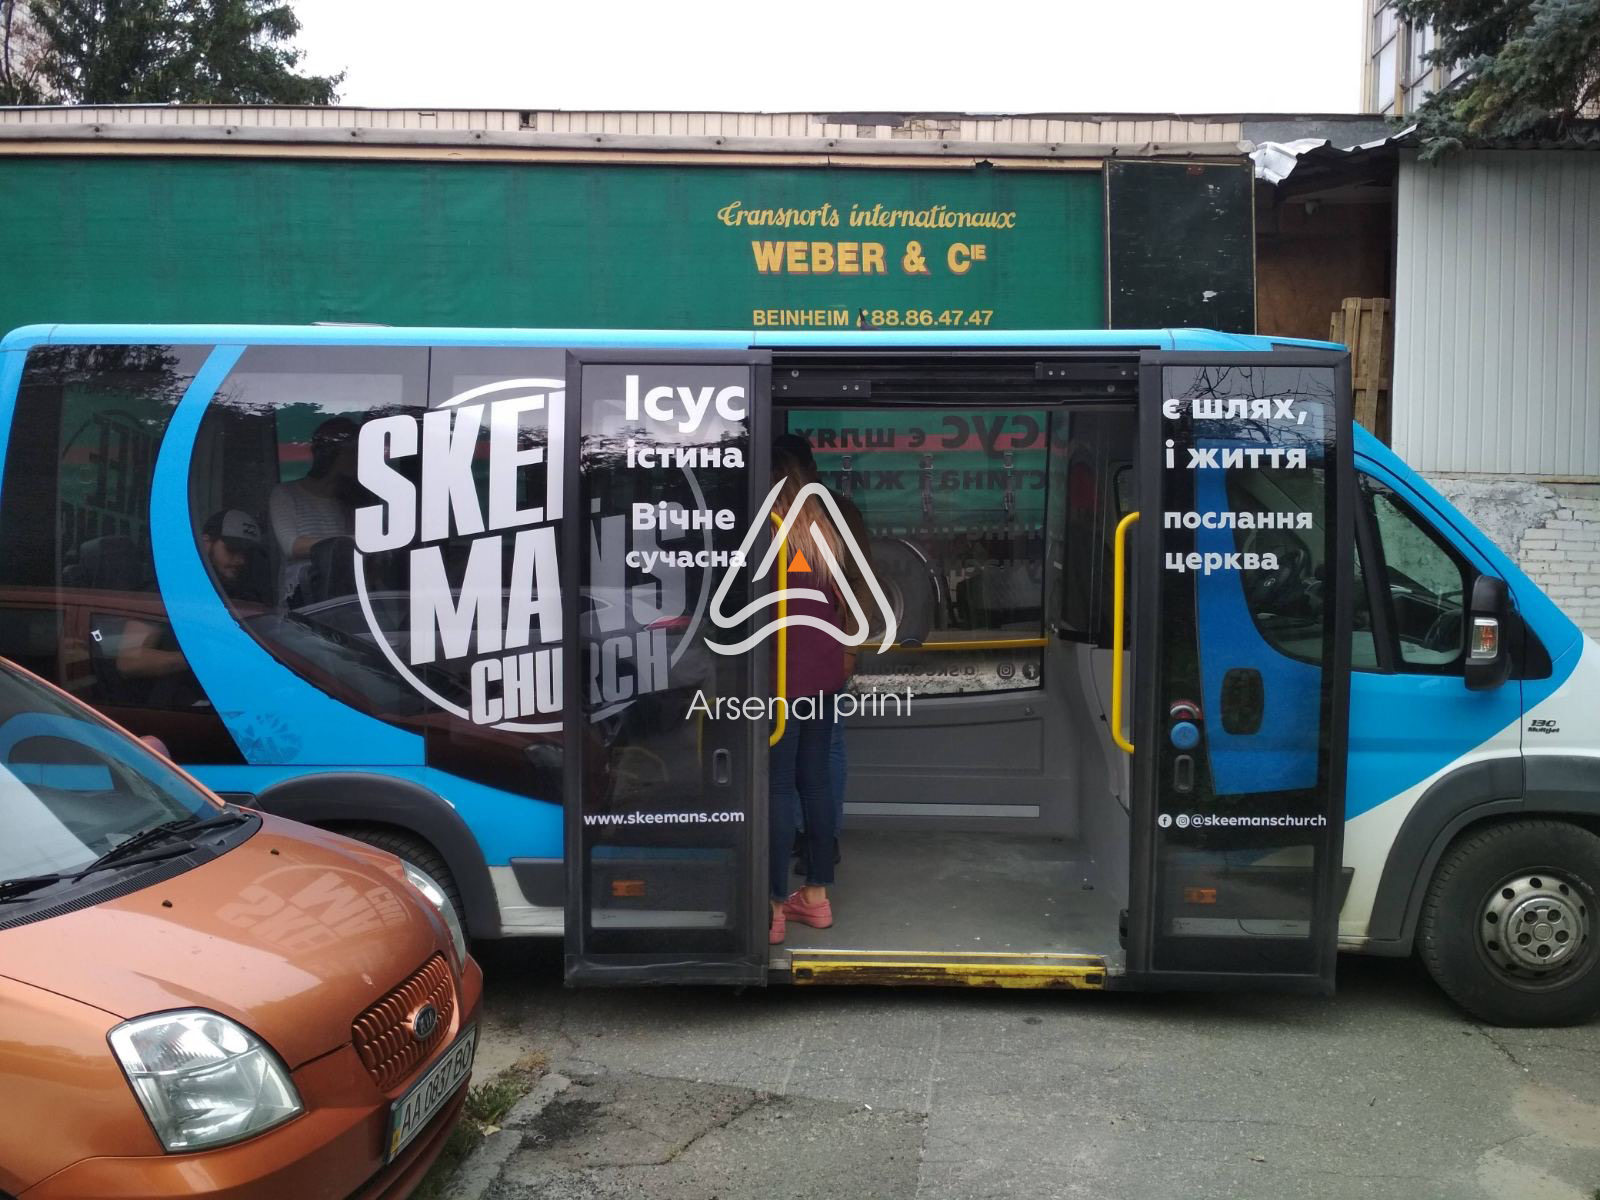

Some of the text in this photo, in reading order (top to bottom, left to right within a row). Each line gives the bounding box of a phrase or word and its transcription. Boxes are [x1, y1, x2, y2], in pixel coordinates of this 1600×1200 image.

[717, 201, 1016, 228] Transports internationaux
[752, 241, 887, 275] WEBER
[903, 240, 930, 275] &
[753, 309, 994, 326] BEINHEIM 88.86.47.47
[625, 375, 745, 433] Ісус
[1162, 399, 1307, 425] є шлях,
[626, 439, 745, 468] істина
[1165, 439, 1307, 469] і життя
[632, 501, 735, 531] Вічне
[1164, 511, 1313, 529] послання
[625, 550, 747, 574] сучасна
[1165, 552, 1280, 576] церква
[584, 810, 745, 826] www.skeemans.com
[1191, 813, 1327, 828] @skeemanschurch
[400, 1092, 421, 1138] AA
